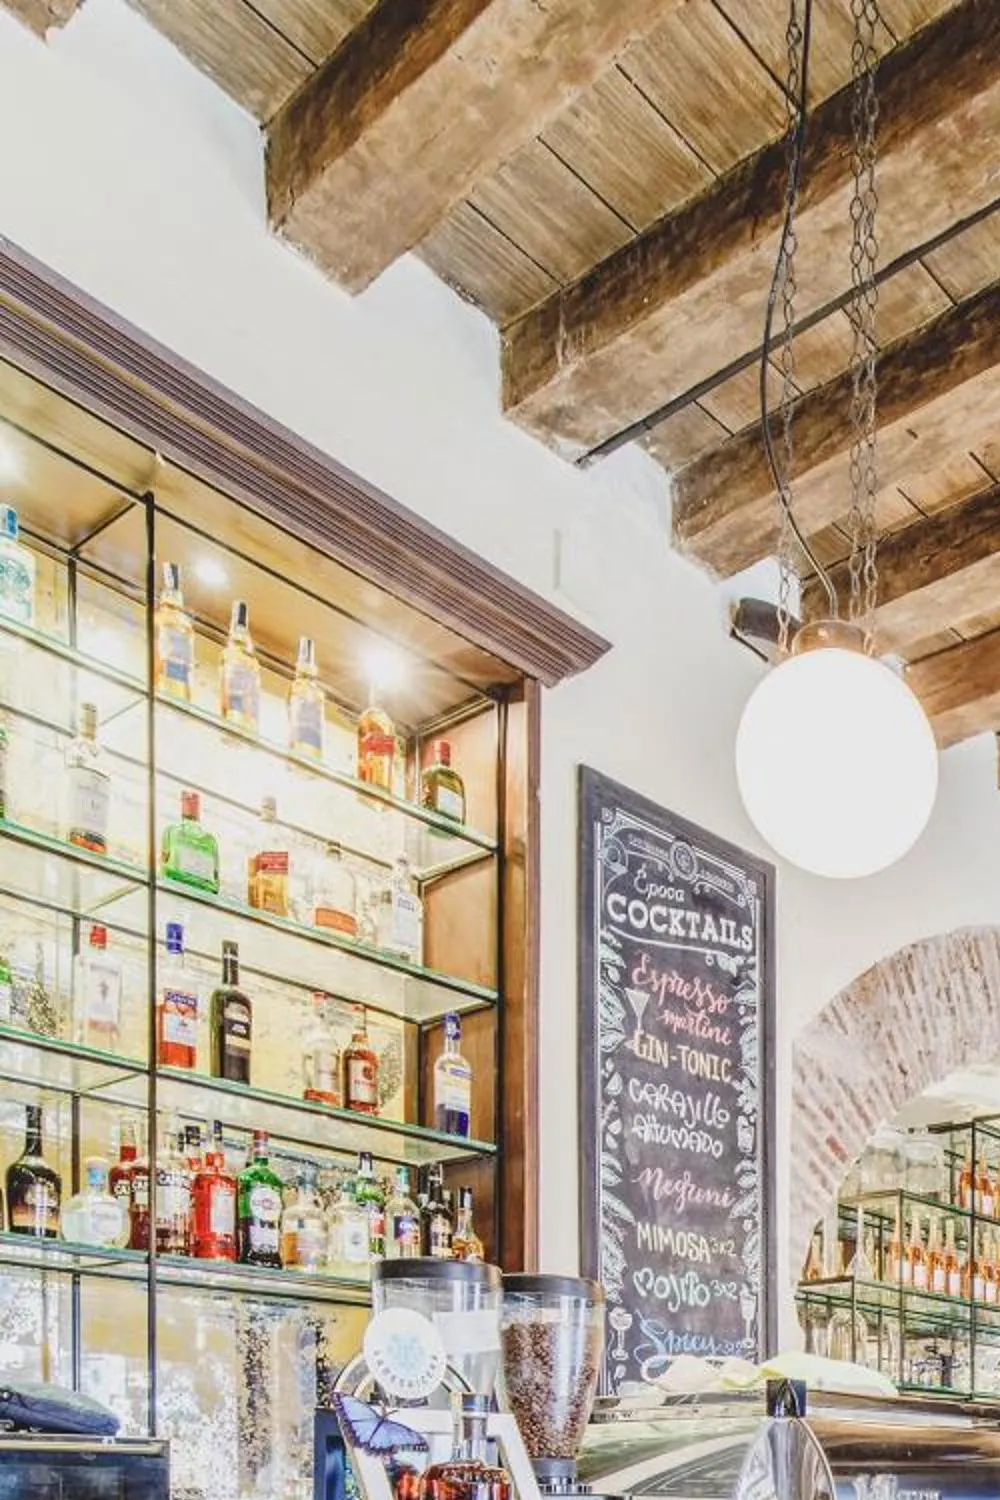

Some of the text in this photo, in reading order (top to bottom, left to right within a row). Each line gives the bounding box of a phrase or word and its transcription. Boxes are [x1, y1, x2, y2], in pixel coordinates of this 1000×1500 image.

[606, 893, 753, 952] COCKTAILS
[633, 1028, 732, 1083] GIN-TONIC
[630, 1166, 736, 1215] Negroni
[636, 1221, 712, 1264] MIMOSA
